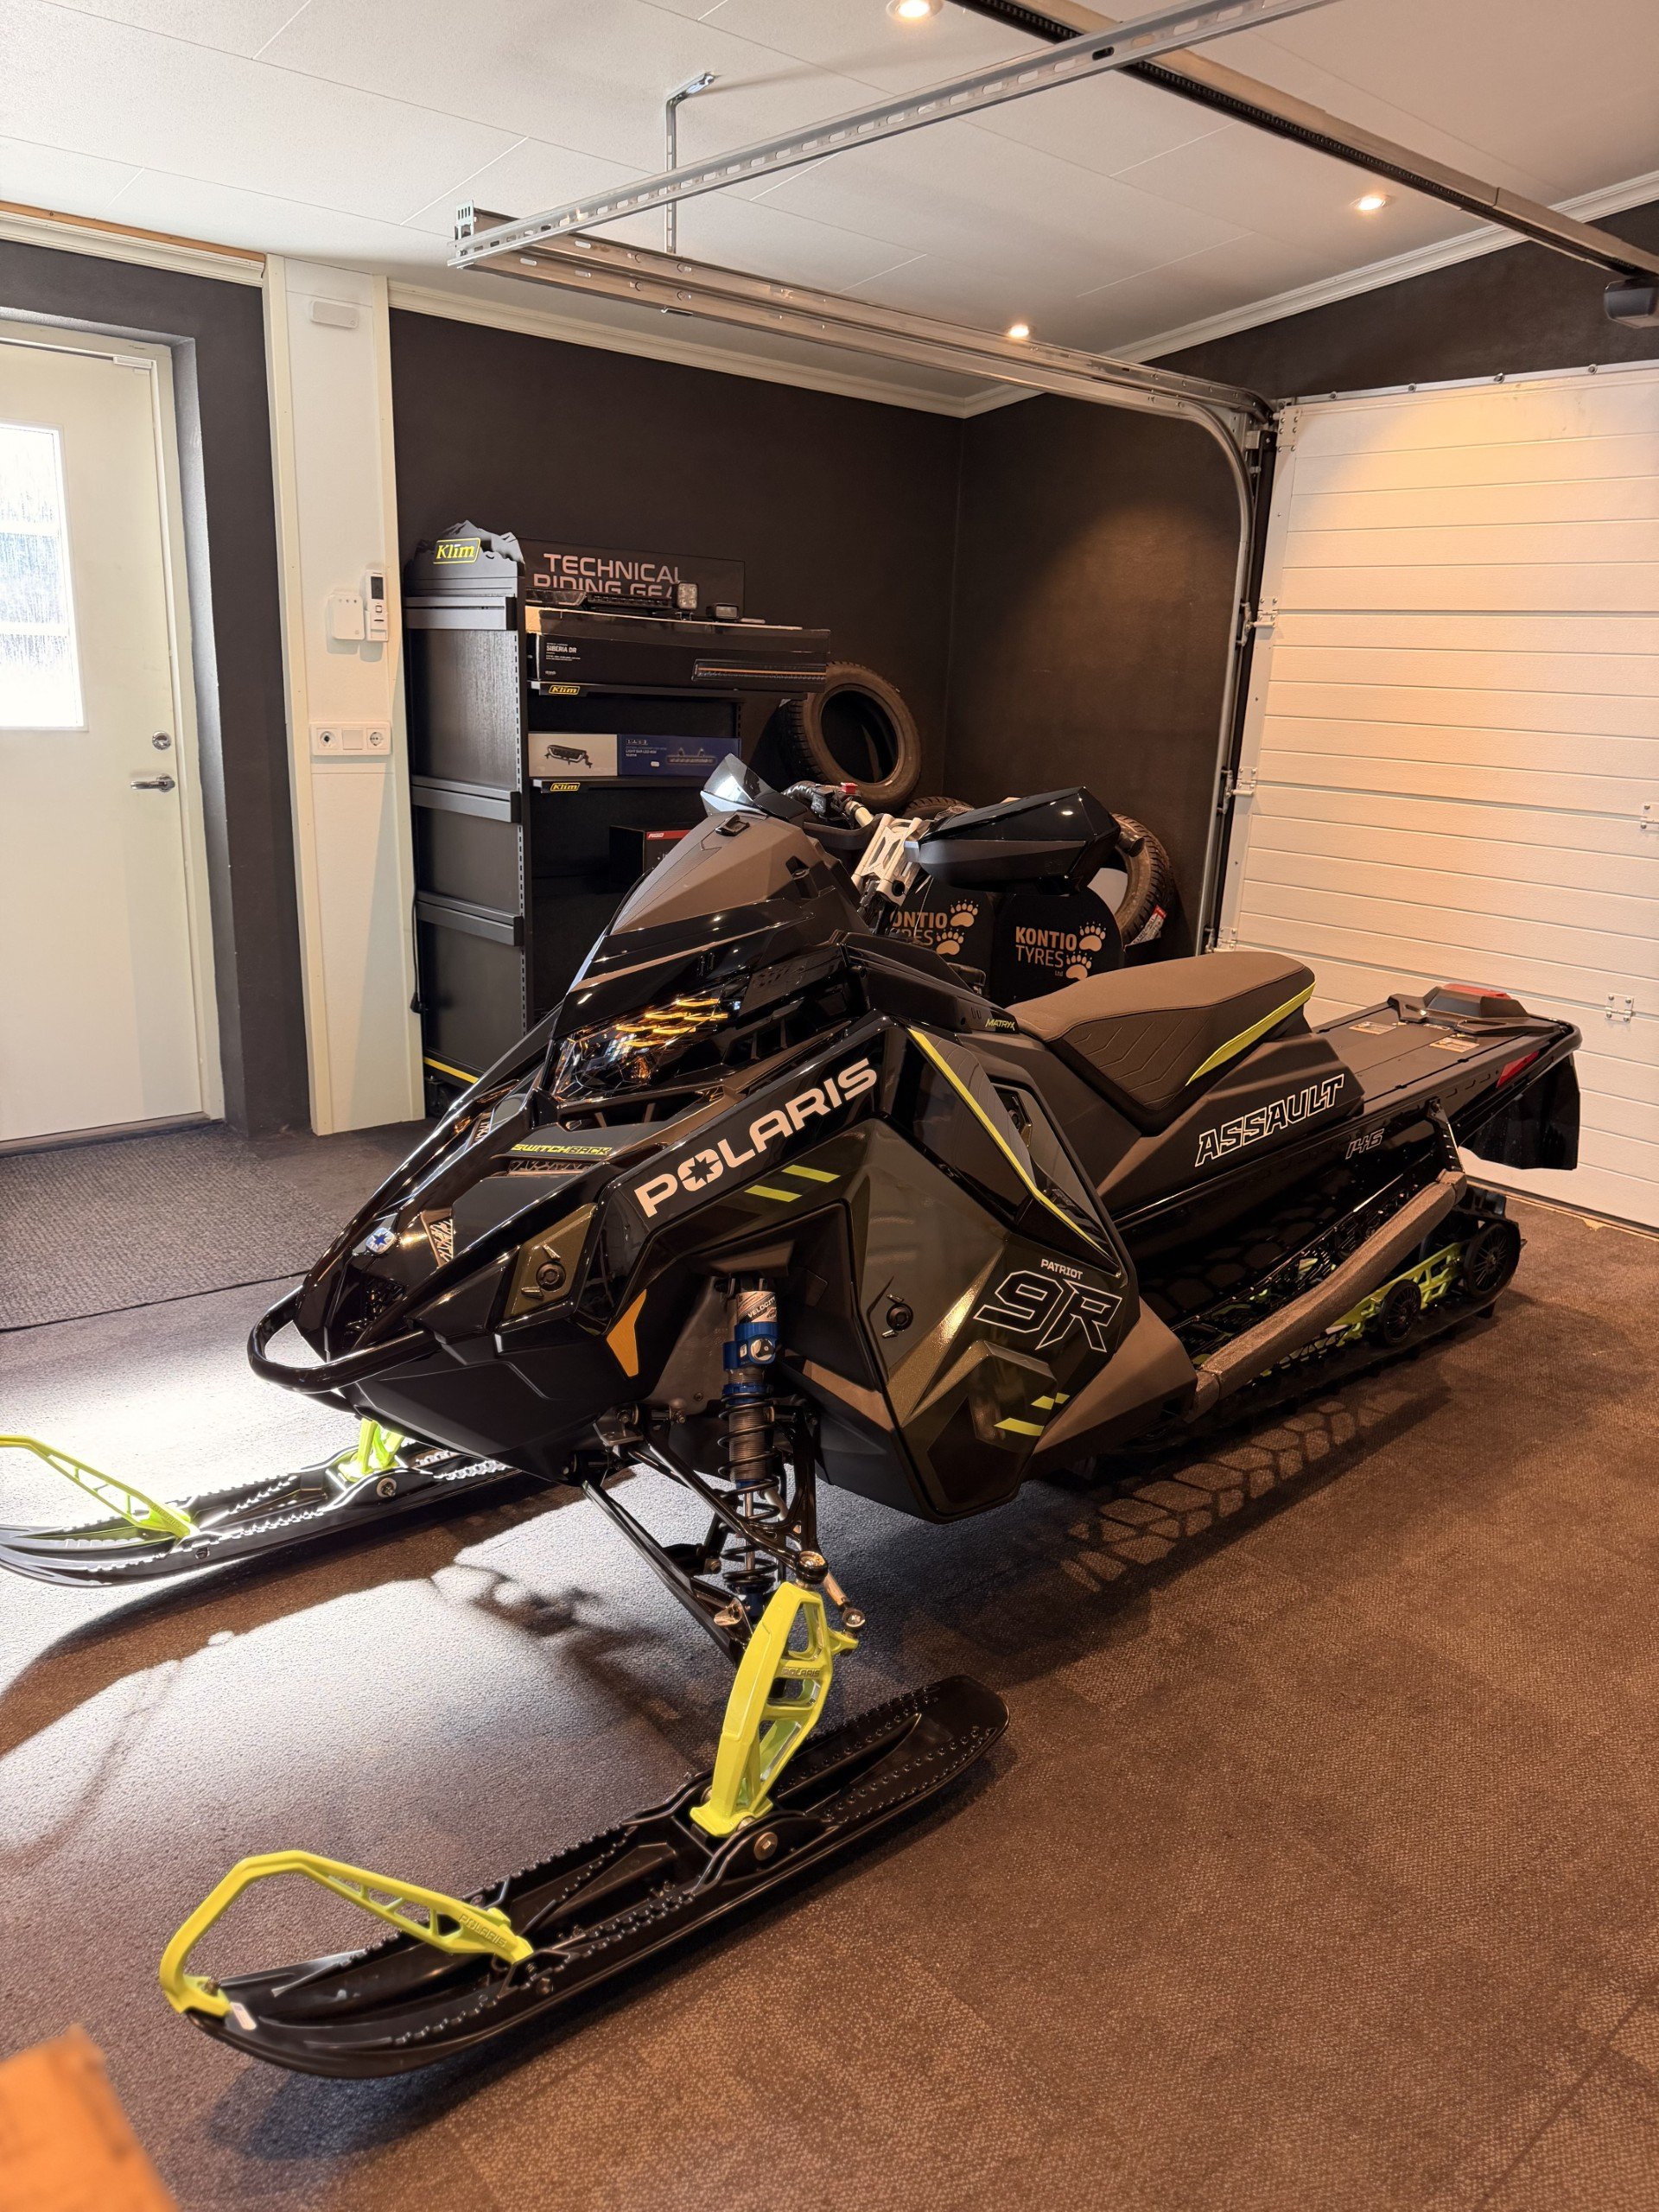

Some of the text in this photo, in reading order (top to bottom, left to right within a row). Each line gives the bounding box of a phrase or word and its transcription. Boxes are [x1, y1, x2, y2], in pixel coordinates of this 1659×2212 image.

[436, 543, 474, 559] Klim
[543, 553, 678, 584] TECHNICAL
[889, 911, 948, 929] ONTIO
[1015, 926, 1077, 951] KONTIO
[1015, 944, 1064, 968] TYRES
[985, 1018, 1015, 1031] MATRYX
[1194, 1073, 1344, 1167] ASSAULT
[511, 1143, 613, 1155] SWITCHBACK
[633, 1058, 878, 1218] POLARIS
[1345, 1128, 1384, 1160] 146
[1040, 1258, 1084, 1280] PATRIOT
[973, 1270, 1122, 1353] 9R
[459, 1914, 507, 1948] POLARIS
